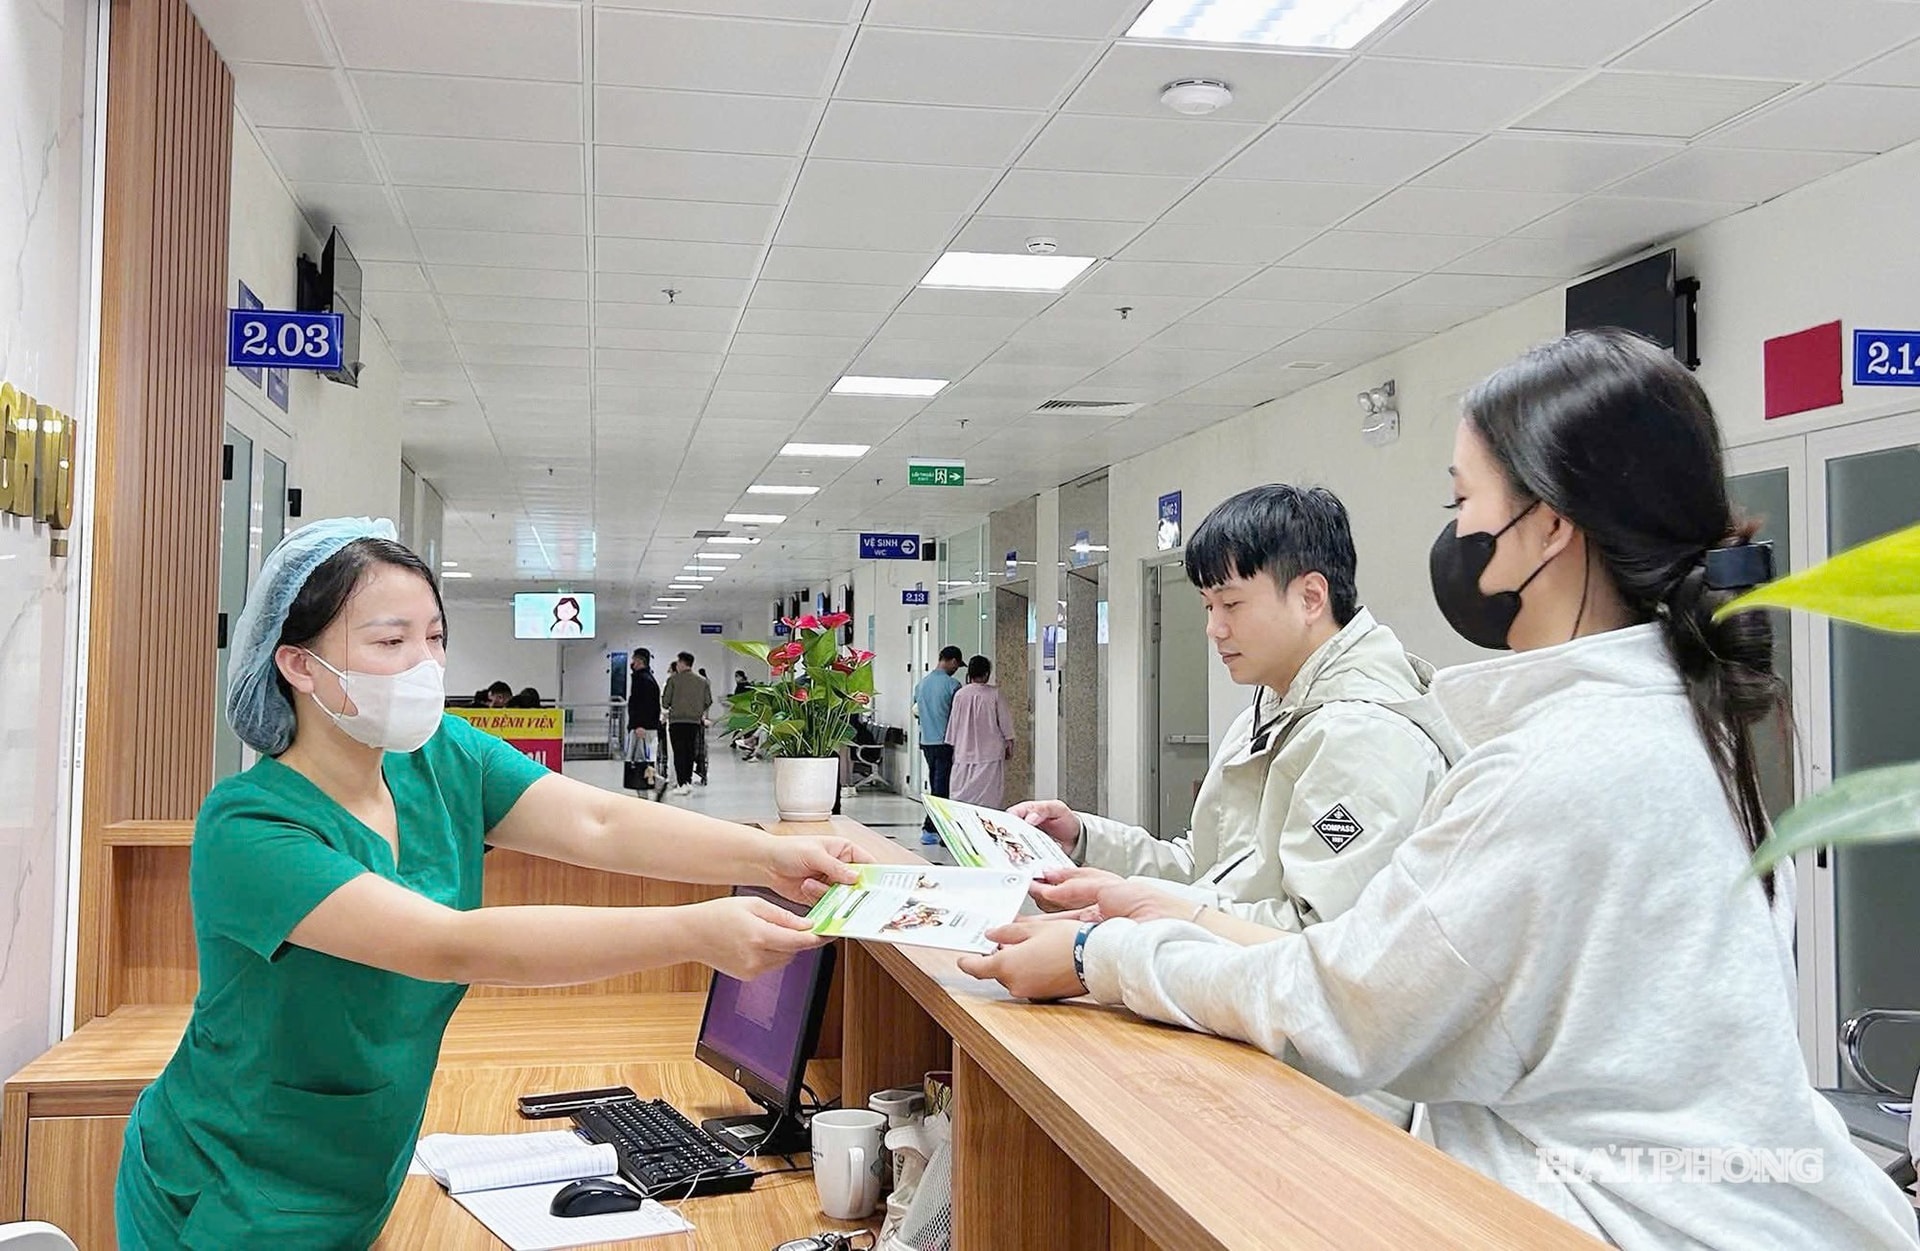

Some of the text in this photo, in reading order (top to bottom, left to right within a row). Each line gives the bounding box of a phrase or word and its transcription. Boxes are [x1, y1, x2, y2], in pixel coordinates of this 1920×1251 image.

[242, 321, 330, 358] 2.03
[863, 537, 899, 548] VỆ SINH
[905, 592, 925, 603] 2.13
[470, 713, 556, 732] TIN BỆNH VIỆN
[1321, 823, 1355, 833] COMPASS
